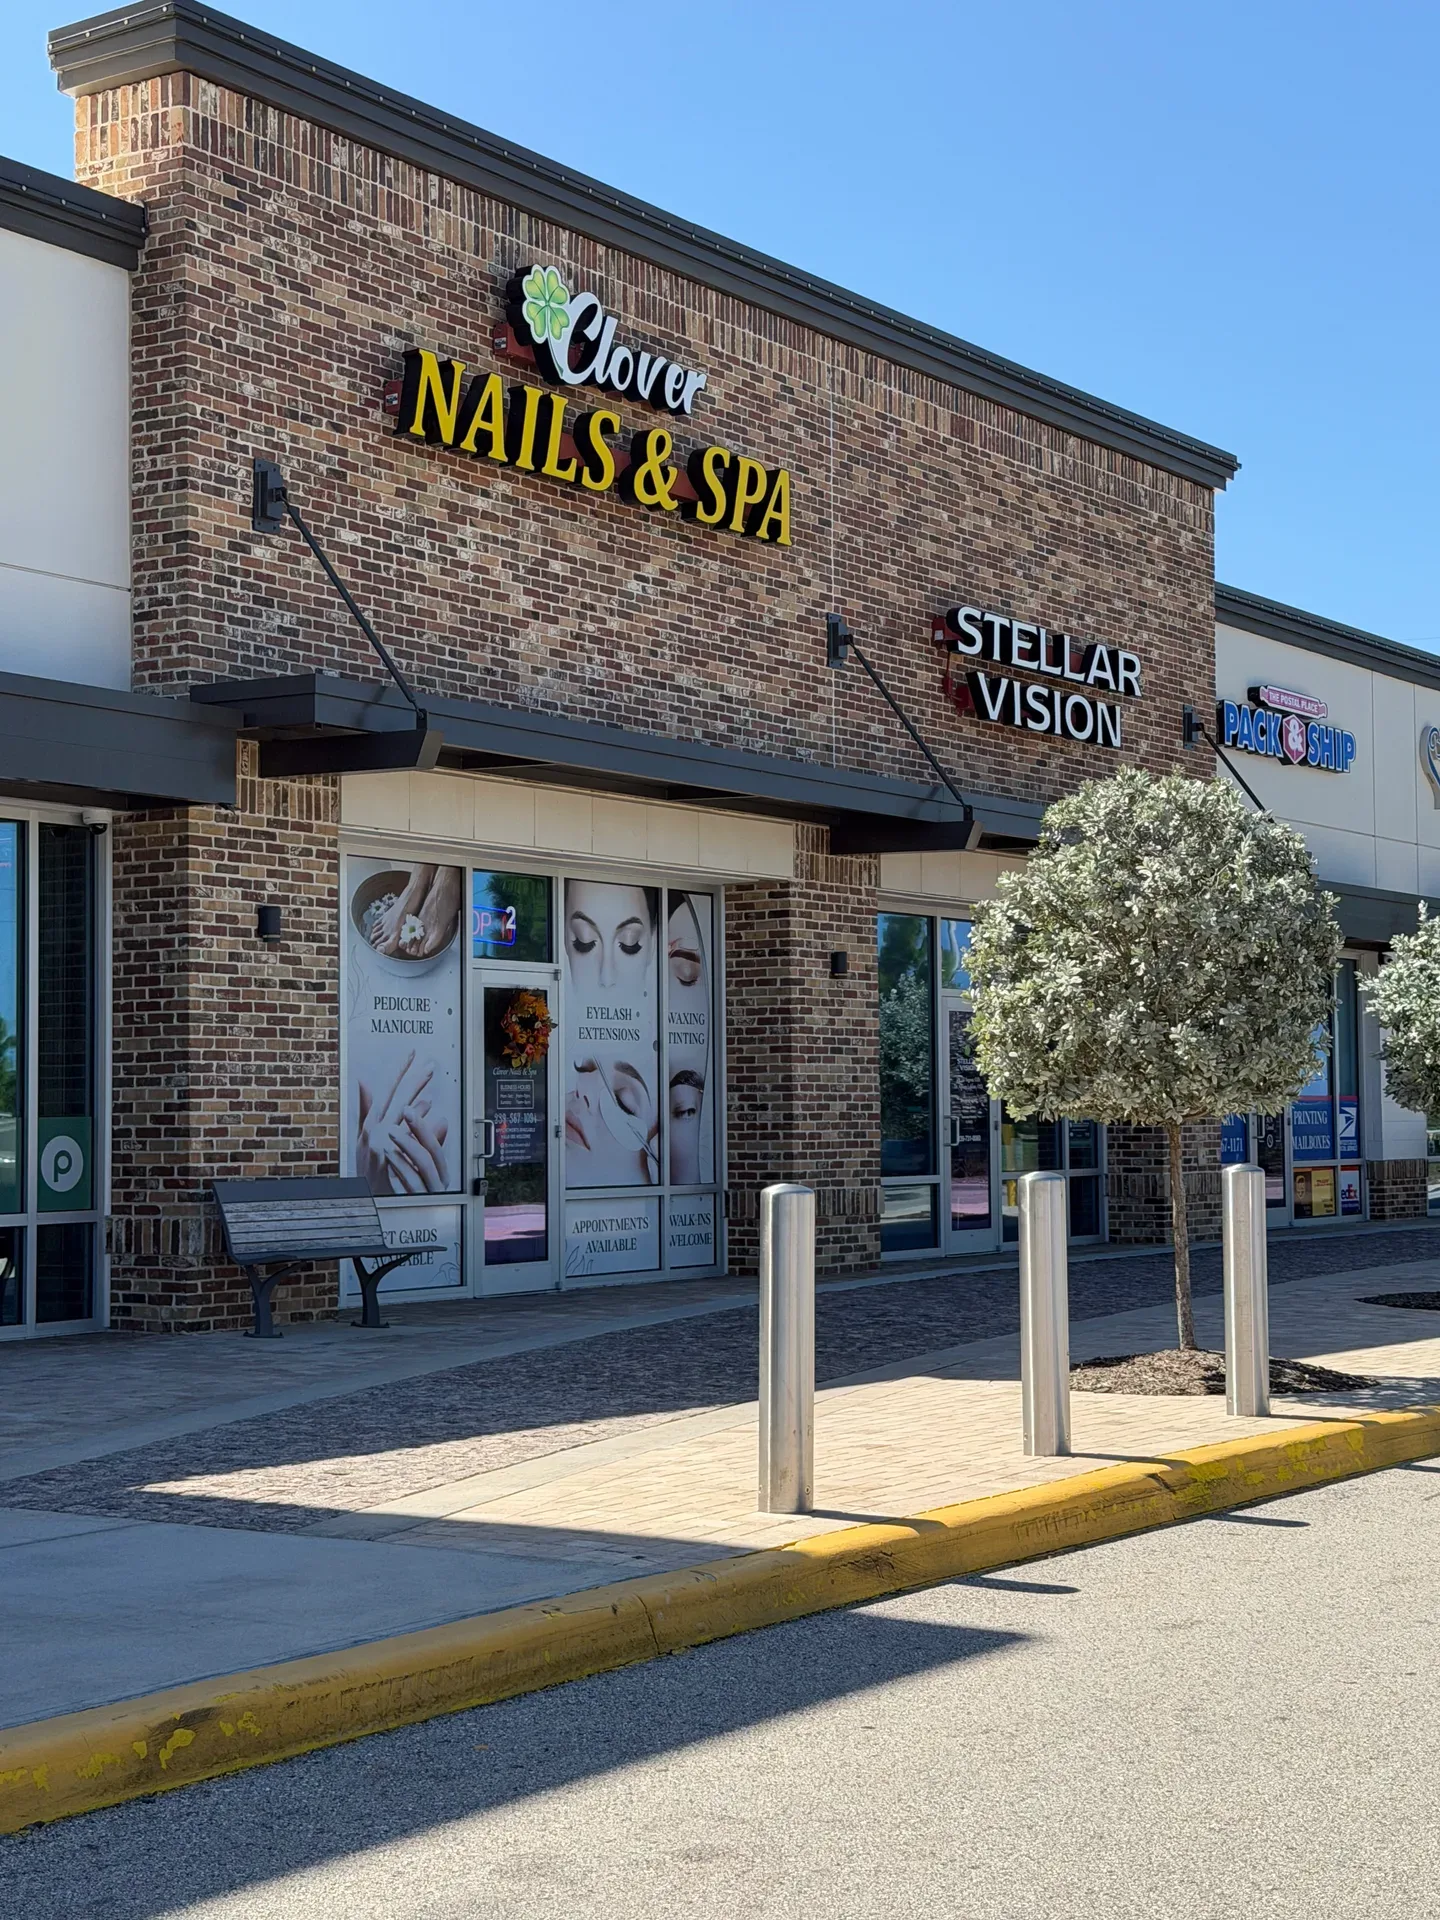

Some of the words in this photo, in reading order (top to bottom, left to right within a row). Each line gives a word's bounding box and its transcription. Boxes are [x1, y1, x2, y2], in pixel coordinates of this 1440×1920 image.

[555, 291, 708, 416] Clover
[409, 349, 621, 491] NAILS
[633, 428, 679, 511] &
[696, 445, 793, 547] SPA
[957, 606, 1142, 697] STELLAR
[976, 671, 1121, 748] VISION
[1268, 691, 1280, 702] THE
[1280, 694, 1301, 708] POSTAL
[1300, 700, 1319, 713] PLACE
[1223, 700, 1284, 758] PACK
[1287, 717, 1304, 752] &
[1307, 722, 1356, 773] SHIP
[373, 996, 431, 1012] PEDICURE
[586, 1006, 632, 1021] EYELASH
[370, 1019, 434, 1034] MANICURE
[578, 1026, 640, 1041] EXTENSIONS
[1293, 1110, 1328, 1125] PRINTING
[1292, 1135, 1330, 1150] MAILBOXES
[572, 1217, 649, 1234] APPOINTMENTS
[399, 1228, 438, 1245] CARDS
[585, 1238, 637, 1254] AVAILABLE
